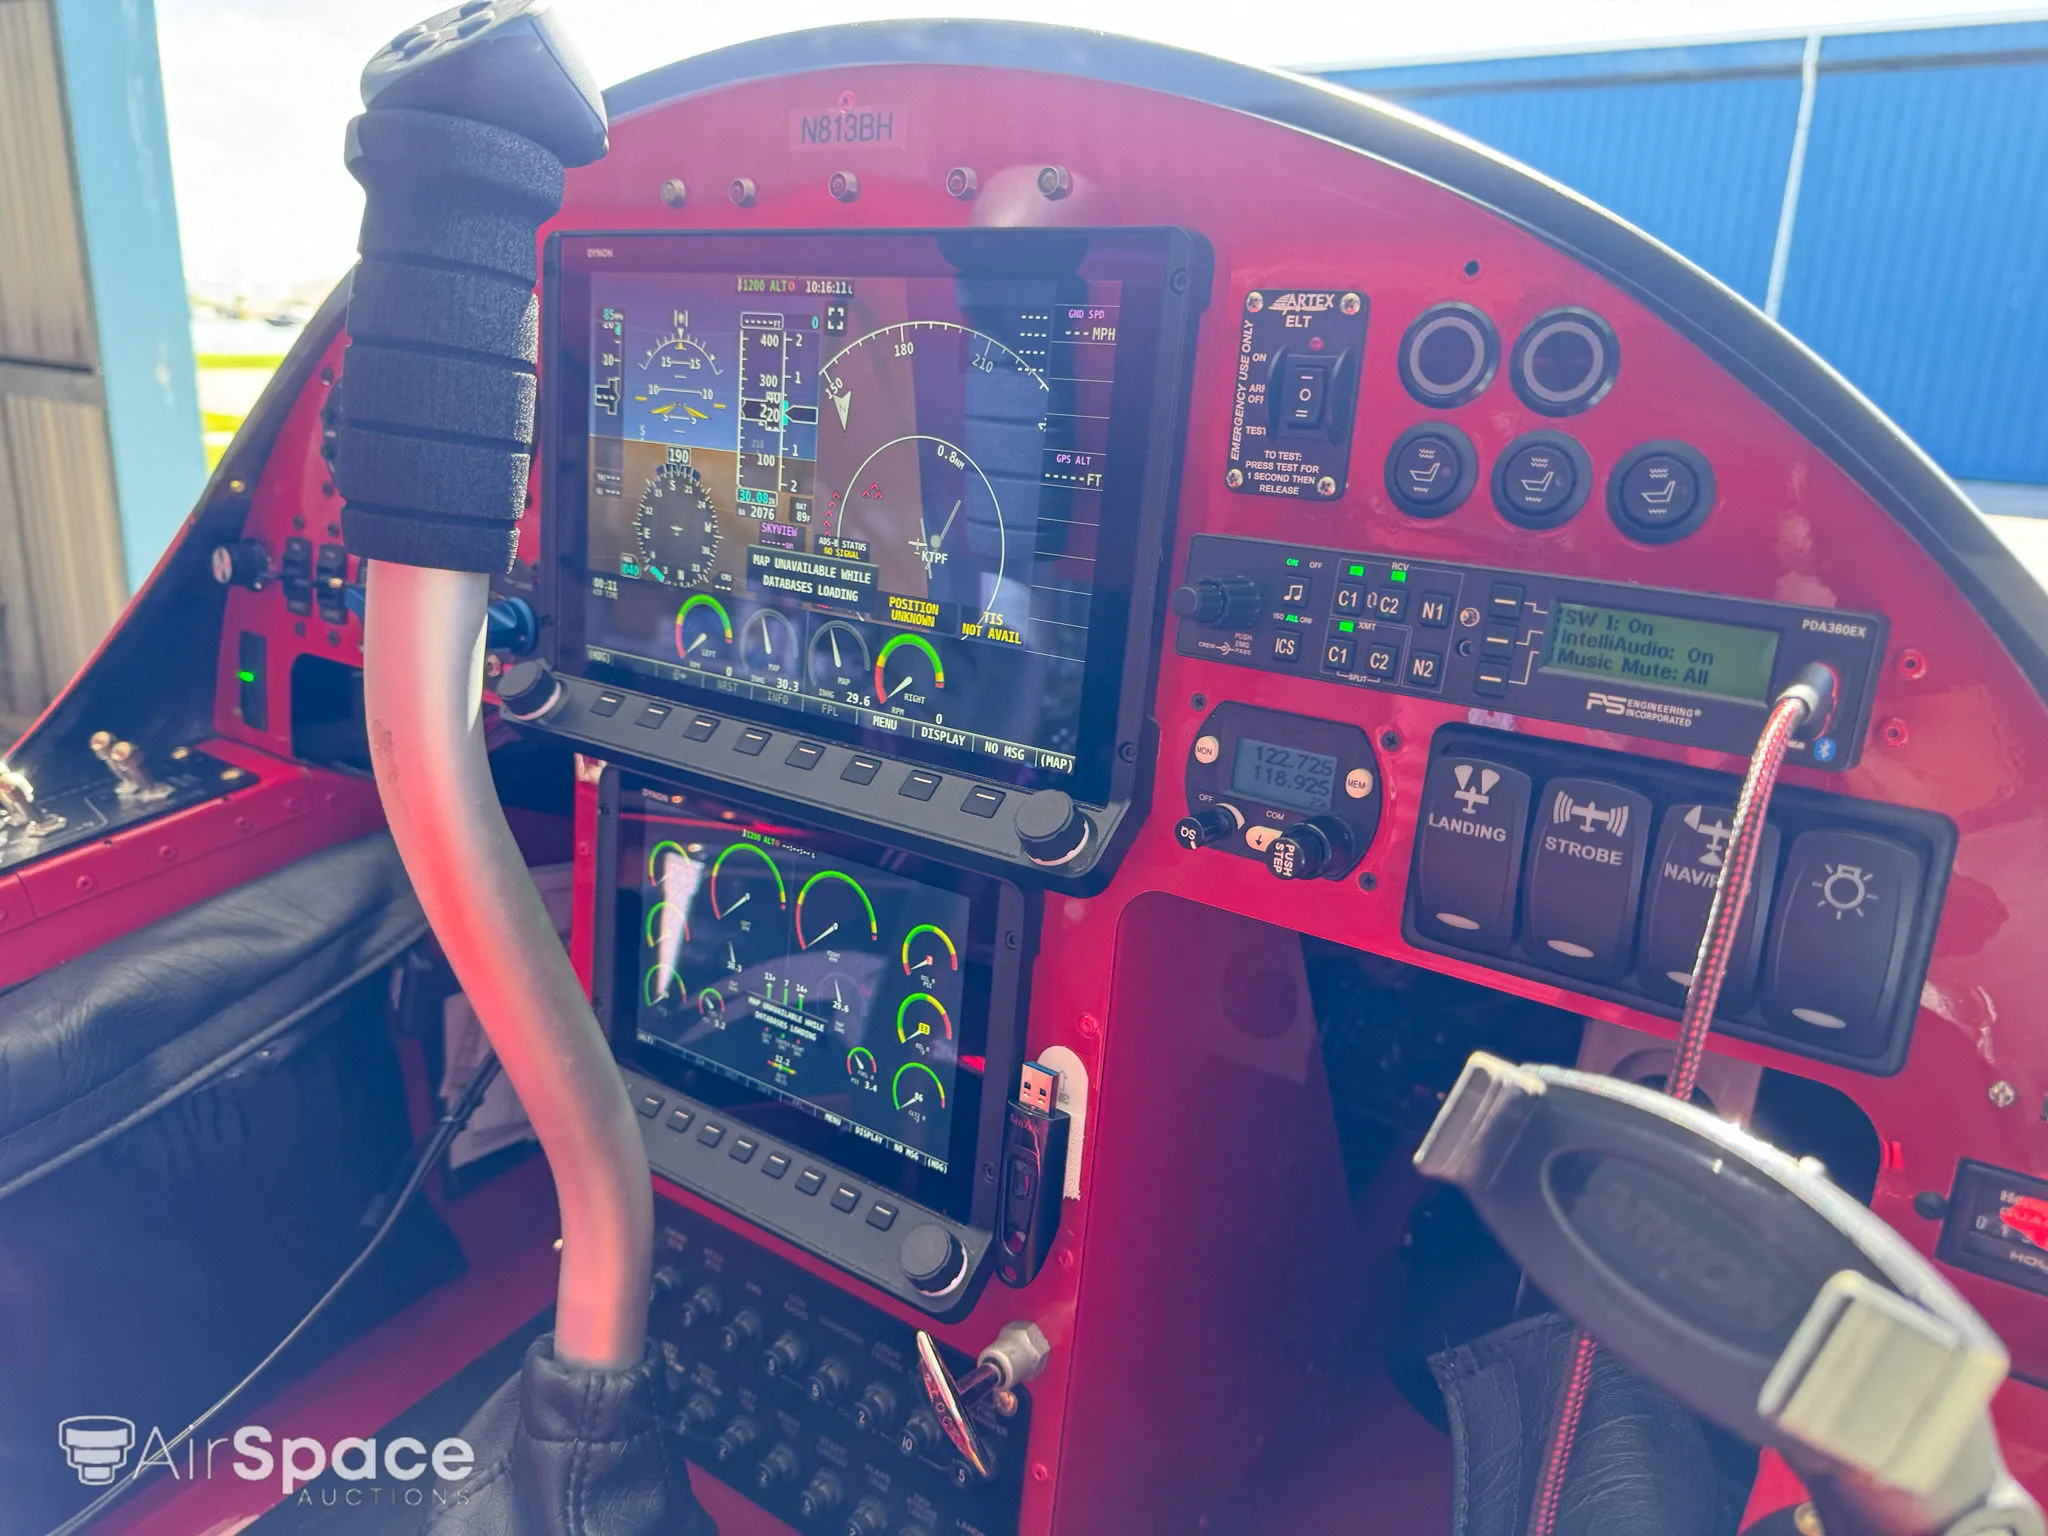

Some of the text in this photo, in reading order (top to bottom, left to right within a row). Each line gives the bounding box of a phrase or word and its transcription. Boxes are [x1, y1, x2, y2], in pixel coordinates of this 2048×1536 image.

[801, 111, 893, 144] N813BH
[743, 279, 787, 292] 1200 ALT
[1287, 294, 1335, 309] ARTEX
[1068, 309, 1105, 320] GND SPD
[1285, 314, 1313, 329] ELT
[760, 333, 779, 347] 400
[795, 333, 803, 347] 2
[893, 343, 914, 358] 180
[1252, 353, 1267, 362] ON
[971, 354, 994, 374] 210
[759, 374, 778, 388] 300
[795, 371, 801, 384] 1
[824, 378, 844, 399] 150
[1231, 320, 1254, 461] EMERGENCY USE ONLY
[669, 448, 690, 464] 190
[793, 444, 799, 456] 1
[1264, 450, 1302, 462] TO TEST:
[757, 454, 775, 467] 100
[1056, 453, 1091, 466] GPS ALT
[1245, 461, 1320, 474] PRESS TEST FOR
[668, 480, 676, 491] S
[791, 480, 798, 493] 2
[1254, 473, 1289, 483] SECOND
[1292, 474, 1315, 485] THEN
[1259, 484, 1299, 495] RELEASE
[750, 506, 775, 520] 2076
[761, 522, 798, 537] SKYVIEW
[842, 540, 867, 551] STATUS
[835, 549, 860, 559] SIGNAL
[921, 550, 948, 565] KTPF
[752, 554, 872, 585] MAP UNAVAILABLE WHILE
[1286, 558, 1299, 567] ON
[1309, 561, 1322, 569] OFF
[1391, 561, 1410, 571] RCV
[762, 574, 859, 602] DATABASES LOADING
[889, 596, 939, 616] POSITION
[1338, 590, 1358, 608] C1
[1380, 596, 1399, 614] C2
[891, 609, 935, 627] UNKNOWN
[1422, 601, 1444, 620] N1
[983, 611, 1004, 626] TIS
[1564, 608, 1655, 636] SW 1: On
[962, 622, 1022, 645] NOT AVAIL
[1357, 621, 1377, 632] XMT
[1802, 619, 1867, 639] PDA360EX
[1275, 638, 1295, 655] ICS
[1560, 628, 1715, 667] IntelliAudio: On
[1328, 646, 1347, 664] C1
[1369, 652, 1389, 670] C2
[1412, 658, 1434, 677] N2
[1556, 647, 1709, 687] Music Mute: All
[776, 677, 799, 692] 30.3
[1348, 673, 1368, 683] SPLIT
[767, 690, 789, 705] INFO
[846, 691, 871, 707] 29.6
[904, 692, 926, 705] RIGHT
[821, 703, 839, 717] FPL
[872, 715, 898, 731] MENU
[935, 713, 943, 725] 0
[1625, 709, 1692, 728] INCORPORATED
[921, 726, 966, 747] DISPLAY
[984, 740, 1025, 761] NO MSG
[1196, 746, 1213, 756] MON
[1040, 753, 1073, 775] (MAP)
[1255, 745, 1334, 778] 122.725
[1252, 764, 1331, 797] 118.925
[1347, 778, 1366, 790] MEM
[1199, 793, 1214, 803] OFF
[1266, 810, 1285, 821] COM
[1428, 813, 1508, 844] LANDING
[1273, 842, 1285, 873] STEP
[1545, 836, 1624, 867] STROBE
[1285, 844, 1296, 877] PUSH
[855, 1126, 883, 1145] DISPLAY
[902, 1437, 913, 1451] 10
